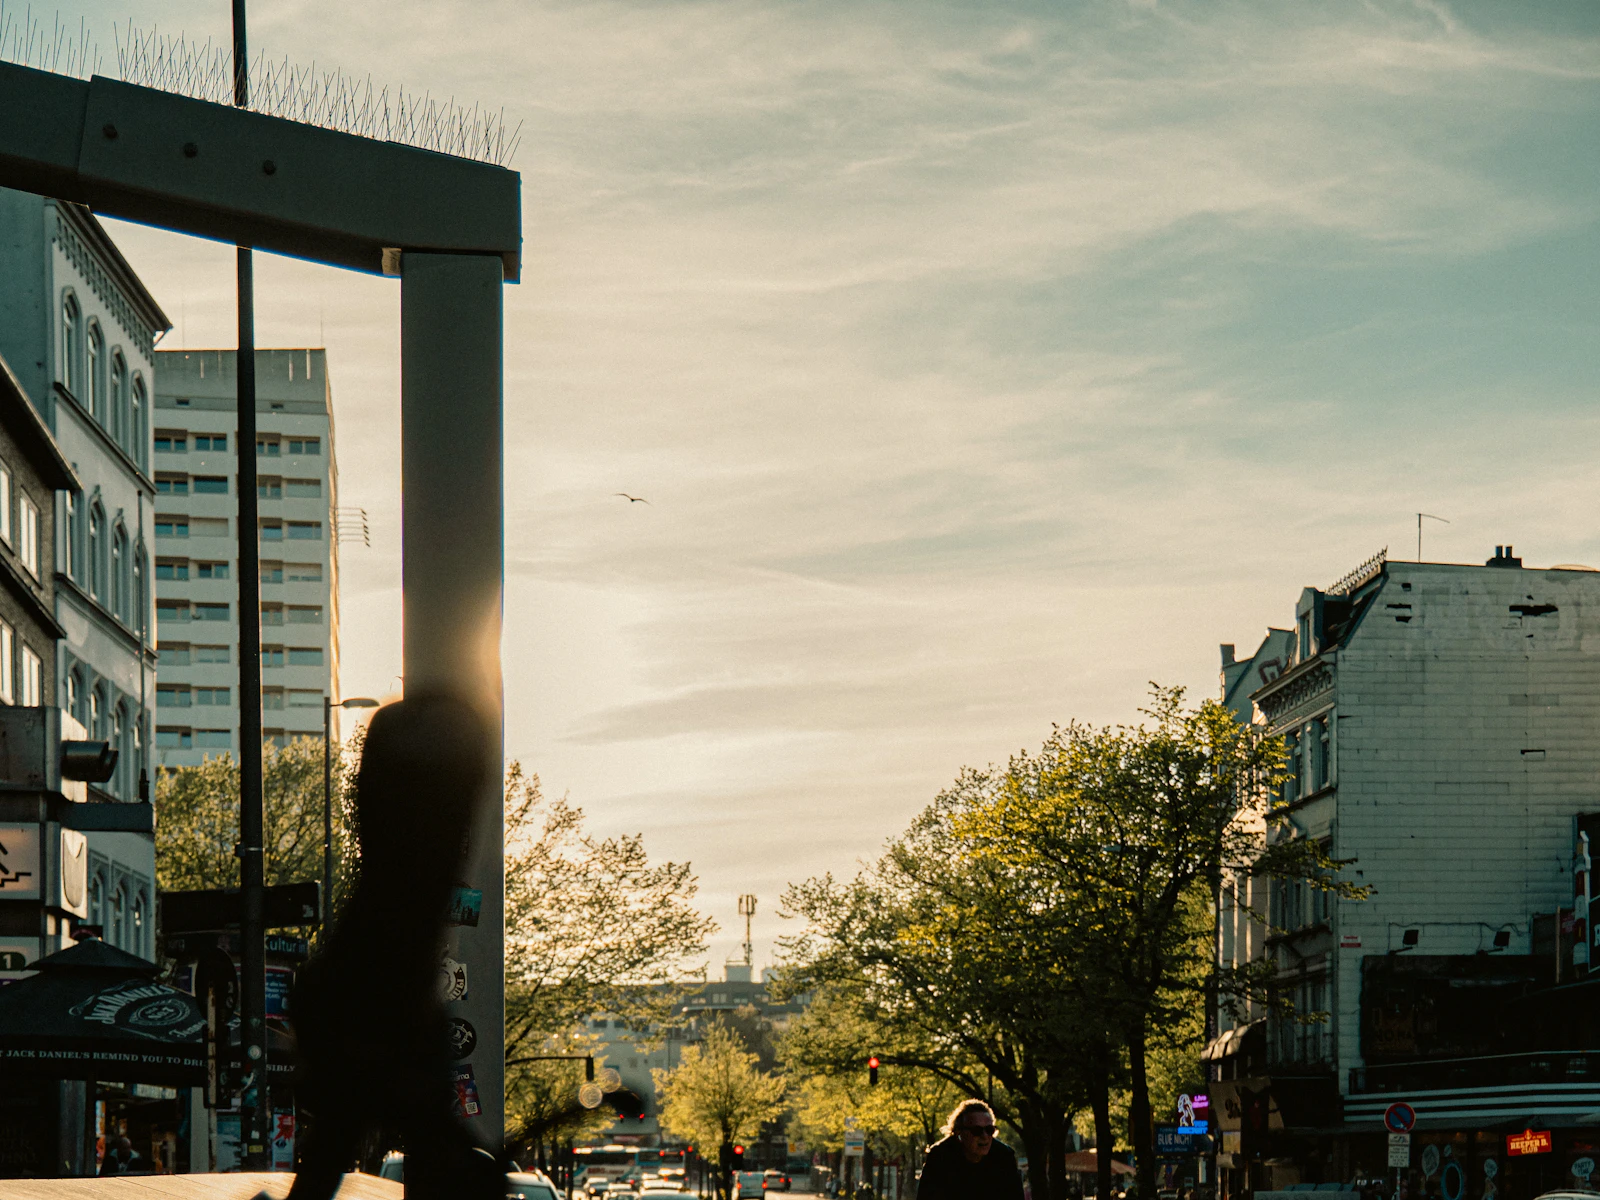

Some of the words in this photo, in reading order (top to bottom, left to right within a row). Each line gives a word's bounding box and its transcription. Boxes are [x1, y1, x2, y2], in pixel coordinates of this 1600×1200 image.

[6, 1050, 36, 1058] JACK
[39, 1050, 90, 1059] DANIEL'S
[92, 1052, 139, 1061] REMIND
[141, 1055, 163, 1064] YOU
[166, 1056, 181, 1065] TO
[1521, 1146, 1538, 1154] CLUB
